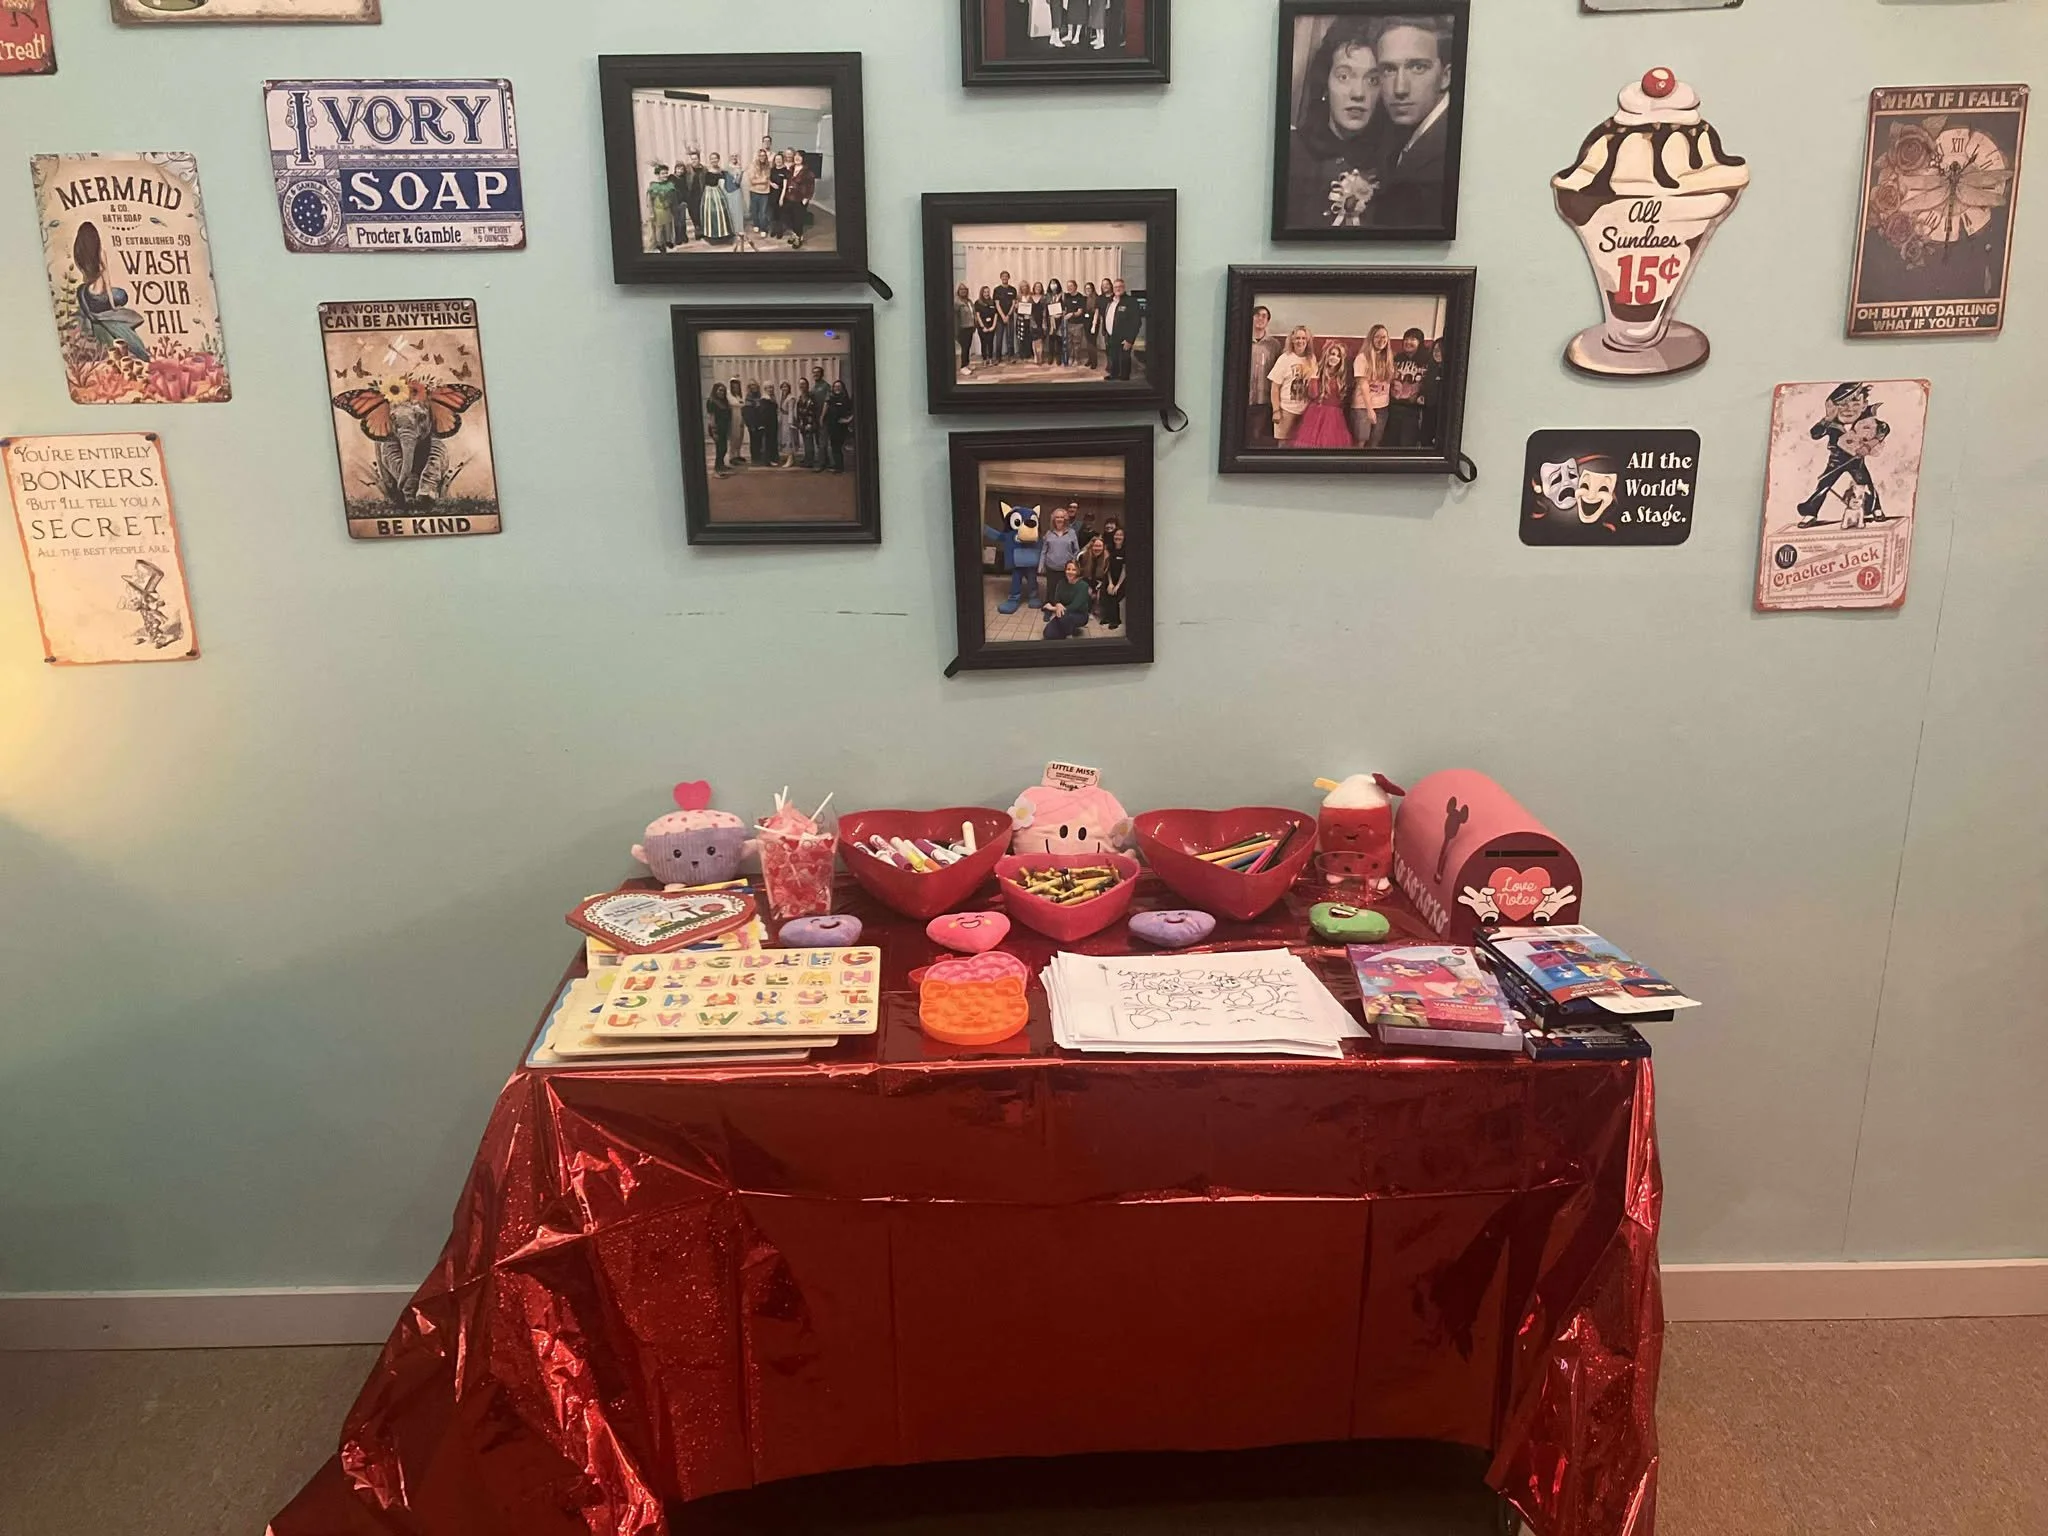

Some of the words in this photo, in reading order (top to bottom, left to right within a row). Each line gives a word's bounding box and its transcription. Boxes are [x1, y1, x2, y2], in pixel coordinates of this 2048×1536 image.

[1881, 93, 1935, 109] WHAT
[1939, 92, 1954, 108] IF
[1958, 91, 1964, 107] I
[1968, 91, 2019, 107] FALL?
[286, 90, 491, 166] IVORY
[54, 175, 183, 212] MERMAID
[349, 171, 508, 212] SOAP
[110, 204, 116, 212] &
[1628, 200, 1663, 224] All
[103, 214, 122, 223] BATH
[123, 214, 142, 223] SOAP
[112, 235, 122, 247] 19
[125, 236, 174, 246] ESTABLISHED
[357, 226, 400, 244] Procter
[403, 227, 412, 244] &
[415, 226, 462, 244] Gamble
[1599, 225, 1682, 253] Sundaes
[119, 250, 191, 275] WASH
[1615, 254, 1681, 305] 15¢
[131, 281, 190, 305] YOUR
[341, 305, 349, 315] A
[352, 303, 395, 314] WORLD
[399, 302, 440, 313] WHERE
[443, 301, 470, 311] YOU
[1857, 309, 1879, 320] OH
[1882, 307, 1908, 319] BUT
[1911, 306, 1933, 317] MY
[1936, 304, 1997, 317] DARLING
[144, 310, 189, 334] TAIL
[325, 316, 359, 328] CAN
[363, 315, 381, 327] BE
[386, 312, 472, 326] ANYTHING
[1873, 319, 1911, 330] WHAT
[1914, 318, 1925, 329] IF
[1929, 317, 1956, 329] YOU
[1958, 316, 1980, 327] FLY
[78, 446, 151, 461] ENTIRELY
[1626, 452, 1653, 468] All
[1660, 452, 1693, 469] the
[21, 467, 158, 492] BONKERS.
[1621, 510, 1632, 523] a
[1636, 504, 1687, 527] Stage.
[32, 516, 165, 540] SECRET.
[377, 520, 404, 535] BE
[412, 518, 471, 534] KIND
[1779, 550, 1795, 563] NUT
[1773, 560, 1836, 587] Cracker
[1840, 547, 1880, 569] Jack
[1052, 763, 1074, 773] LITTLE
[1076, 767, 1095, 776] MISS
[1501, 876, 1537, 892] Love
[1496, 892, 1539, 906] Notes
